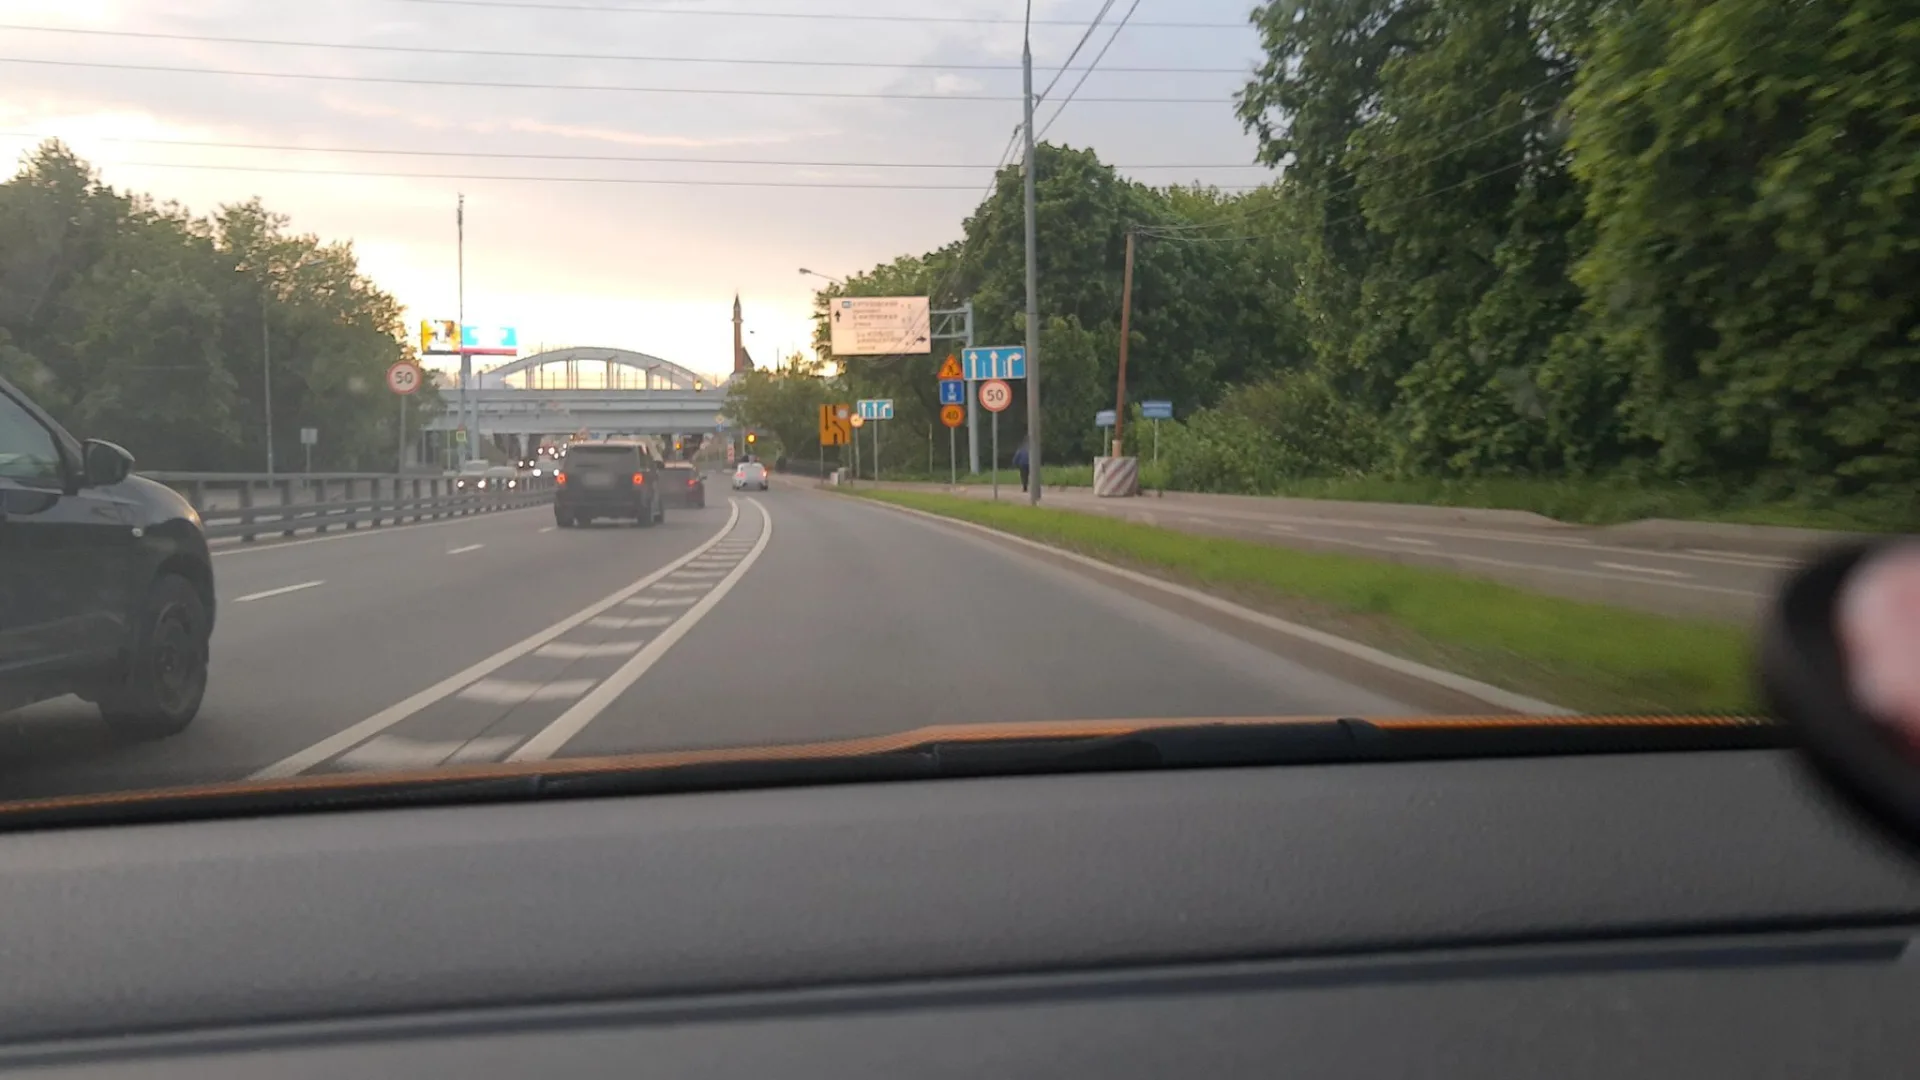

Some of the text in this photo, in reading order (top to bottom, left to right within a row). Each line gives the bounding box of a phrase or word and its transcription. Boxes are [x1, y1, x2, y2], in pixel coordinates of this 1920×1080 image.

[395, 371, 413, 384] 50
[987, 389, 1004, 401] 50
[946, 411, 959, 420] 40
